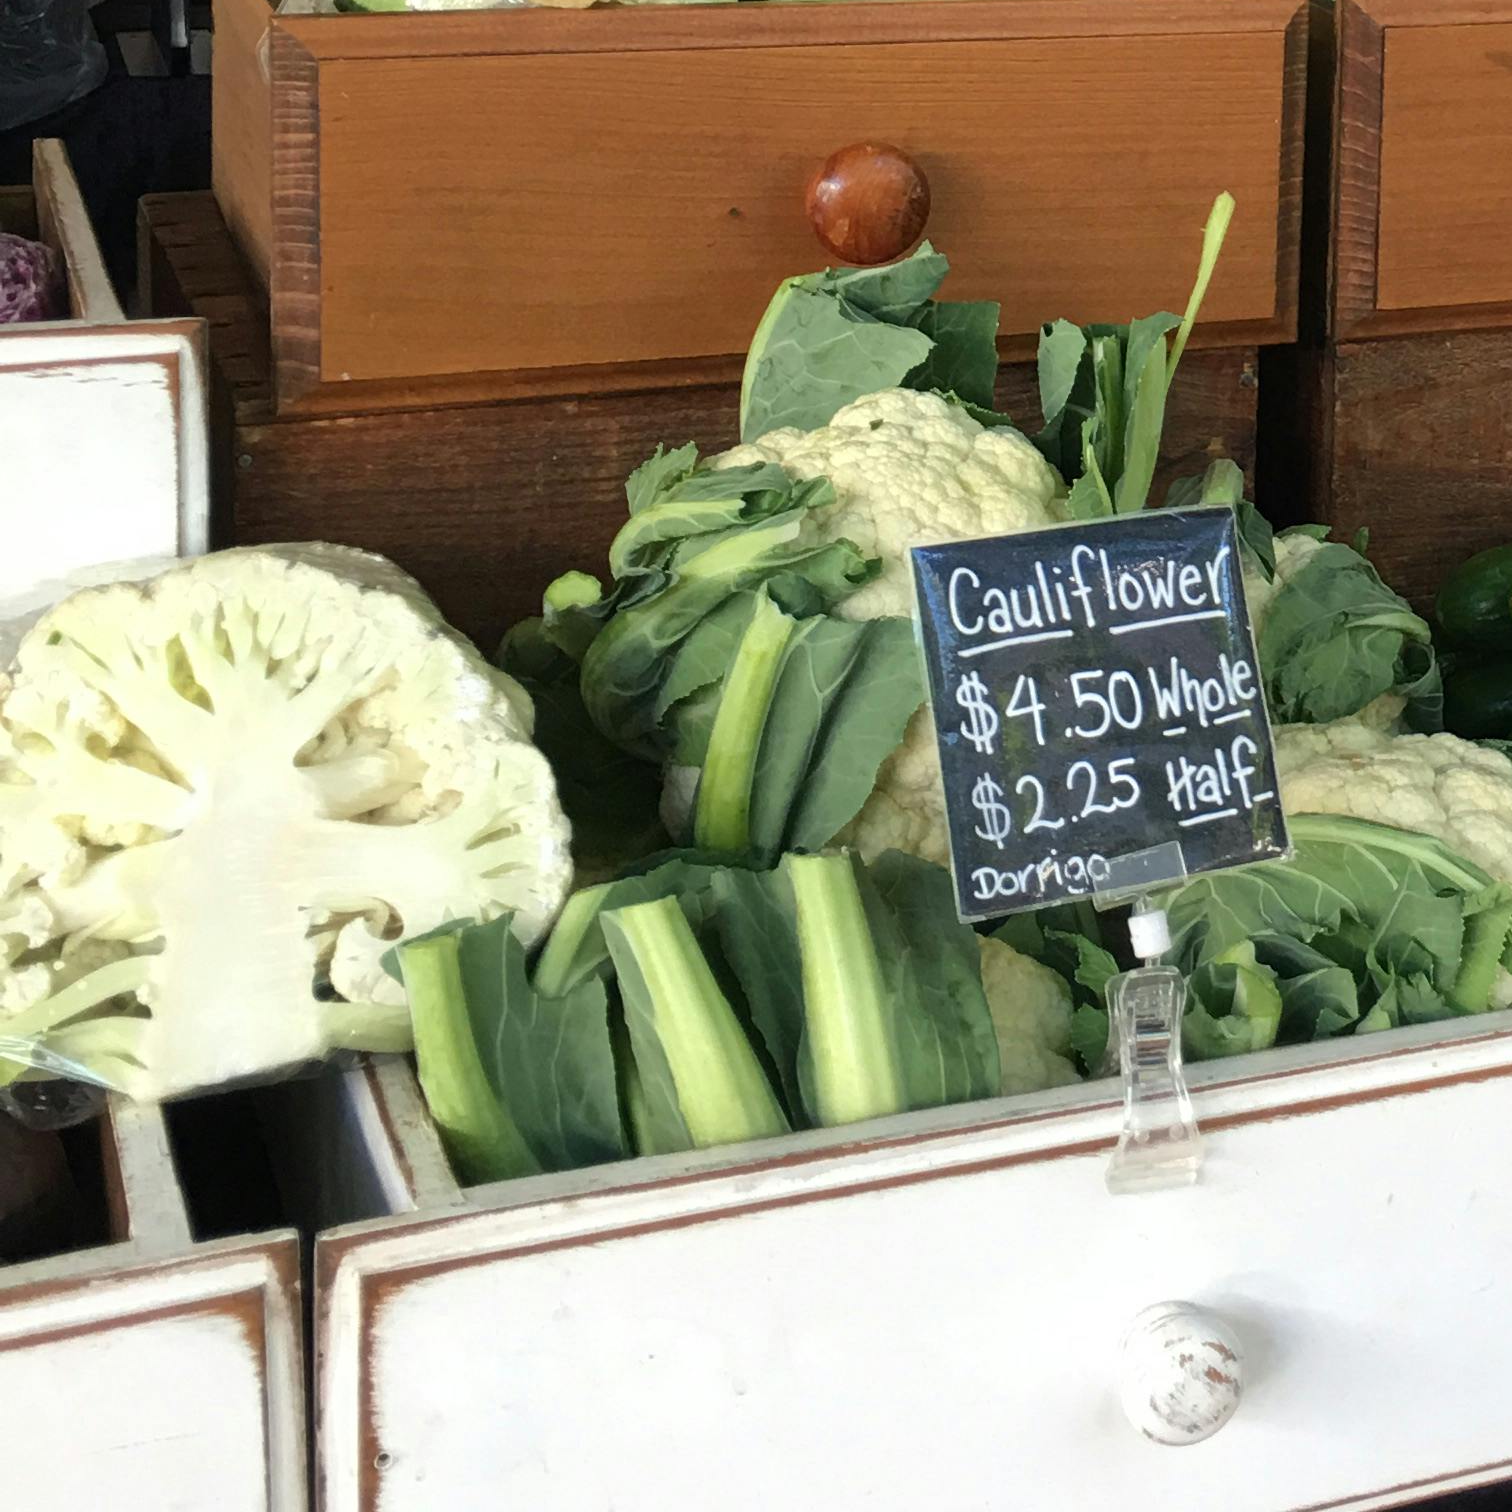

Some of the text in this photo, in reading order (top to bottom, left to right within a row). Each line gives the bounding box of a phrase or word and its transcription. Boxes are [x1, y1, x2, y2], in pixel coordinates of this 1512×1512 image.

[948, 544, 1231, 636] Cauliflower
[955, 653, 1258, 756] $4.50 Whole
[971, 734, 1262, 850] $2.25 Half
[970, 849, 1111, 901] Dorrigo
